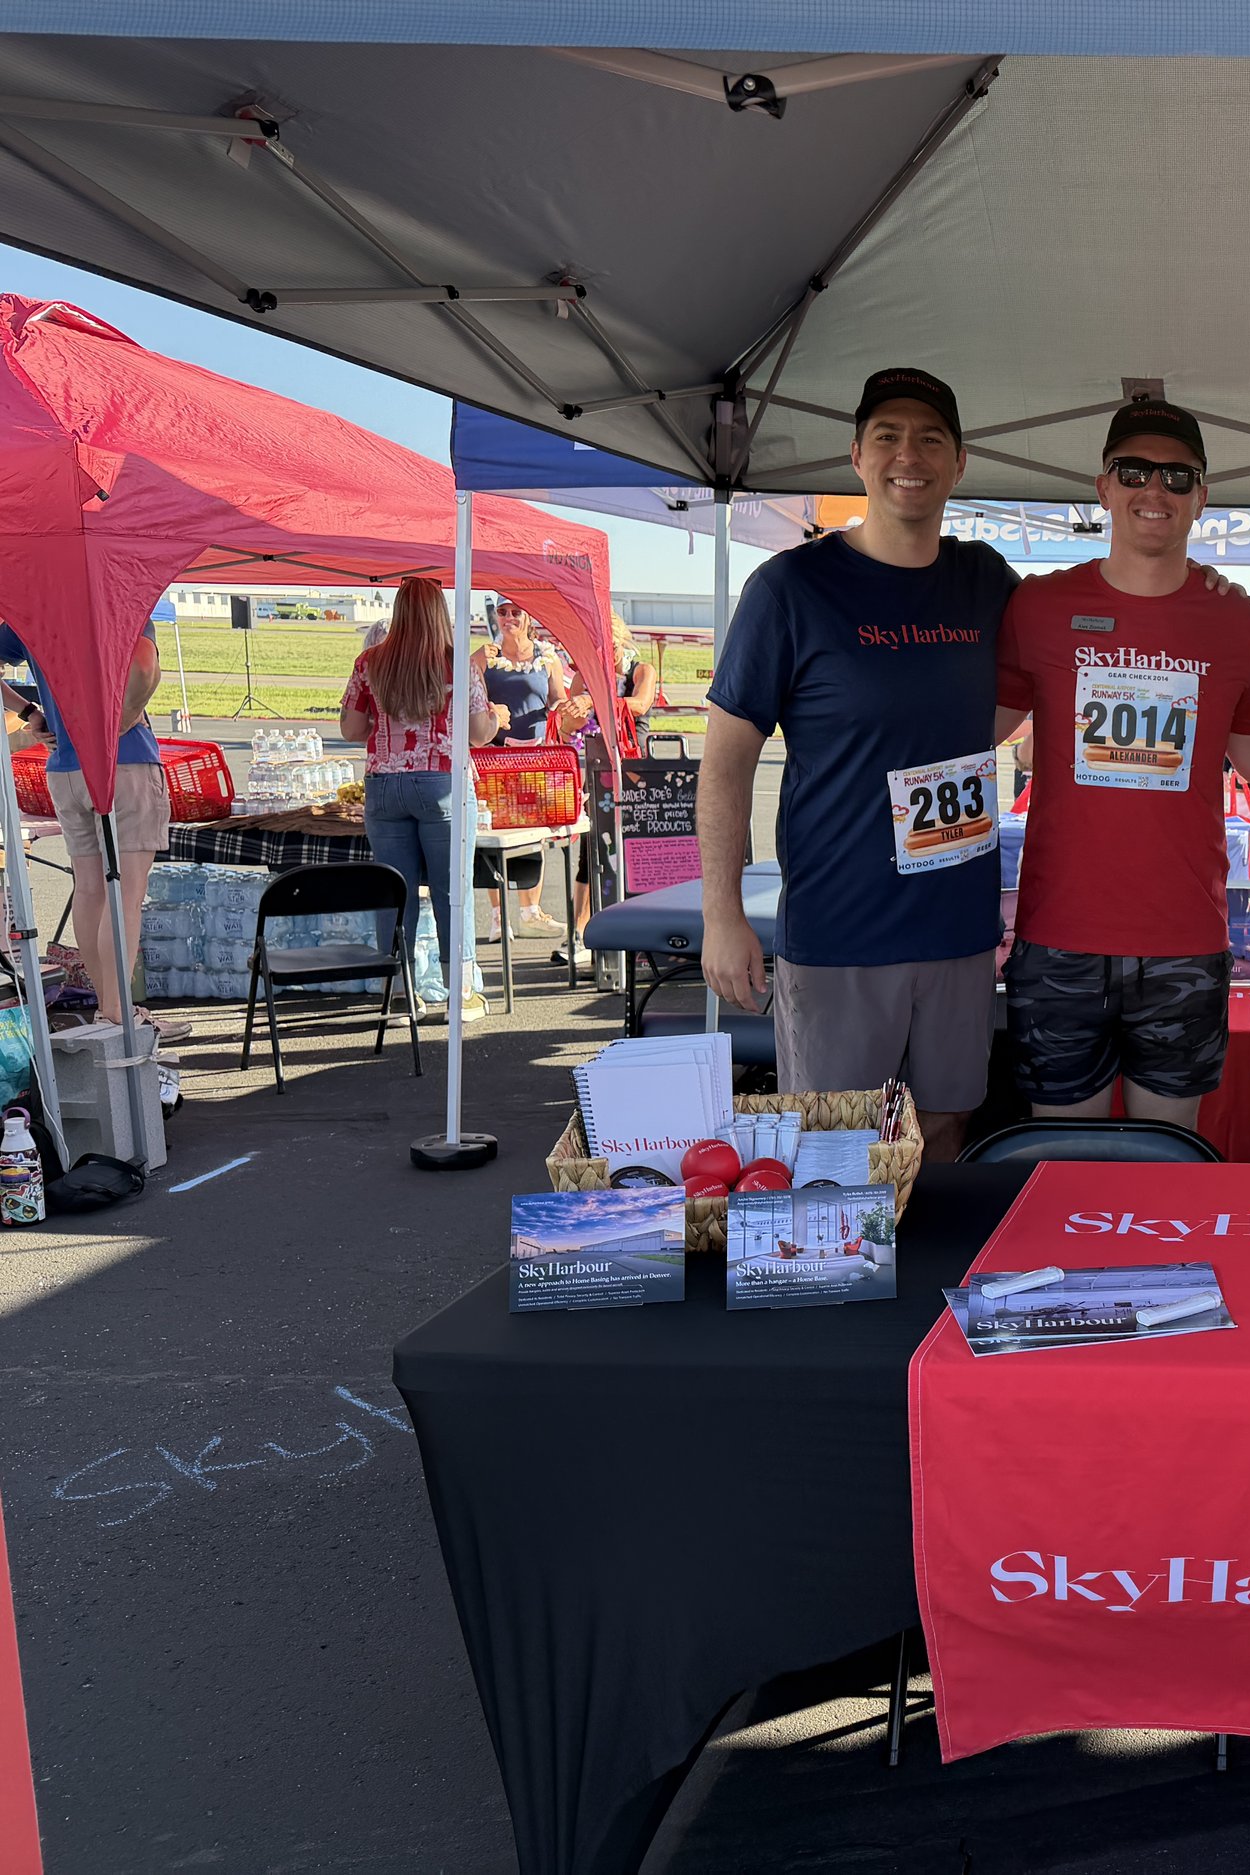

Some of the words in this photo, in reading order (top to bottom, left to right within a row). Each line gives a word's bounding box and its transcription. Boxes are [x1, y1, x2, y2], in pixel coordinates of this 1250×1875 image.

[858, 624, 980, 650] SkyHarbour
[1075, 646, 1211, 676] SkyHarbour
[1129, 673, 1152, 681] CHECK
[1091, 689, 1123, 700] RUNWAY
[1122, 691, 1136, 701] 5K
[1083, 701, 1187, 750] 2014
[1110, 751, 1158, 763] ALEXANDER
[903, 774, 933, 787] RUNWAY
[933, 770, 945, 781] 5K
[1076, 773, 1111, 783] HOTDOG
[1160, 779, 1180, 787] BEER
[649, 785, 672, 802] JOE'S
[910, 776, 984, 831] 283
[633, 809, 659, 821] BEST
[647, 820, 692, 833] PRODUCTS
[941, 827, 964, 841] TYLER
[976, 842, 992, 853] BEER
[899, 859, 935, 871] HOTDOG
[519, 1261, 613, 1281] SkyHarbour
[736, 1260, 826, 1280] SkyHarbour
[538, 1280, 564, 1288] approach
[976, 1315, 1127, 1332] SkyHarbour
